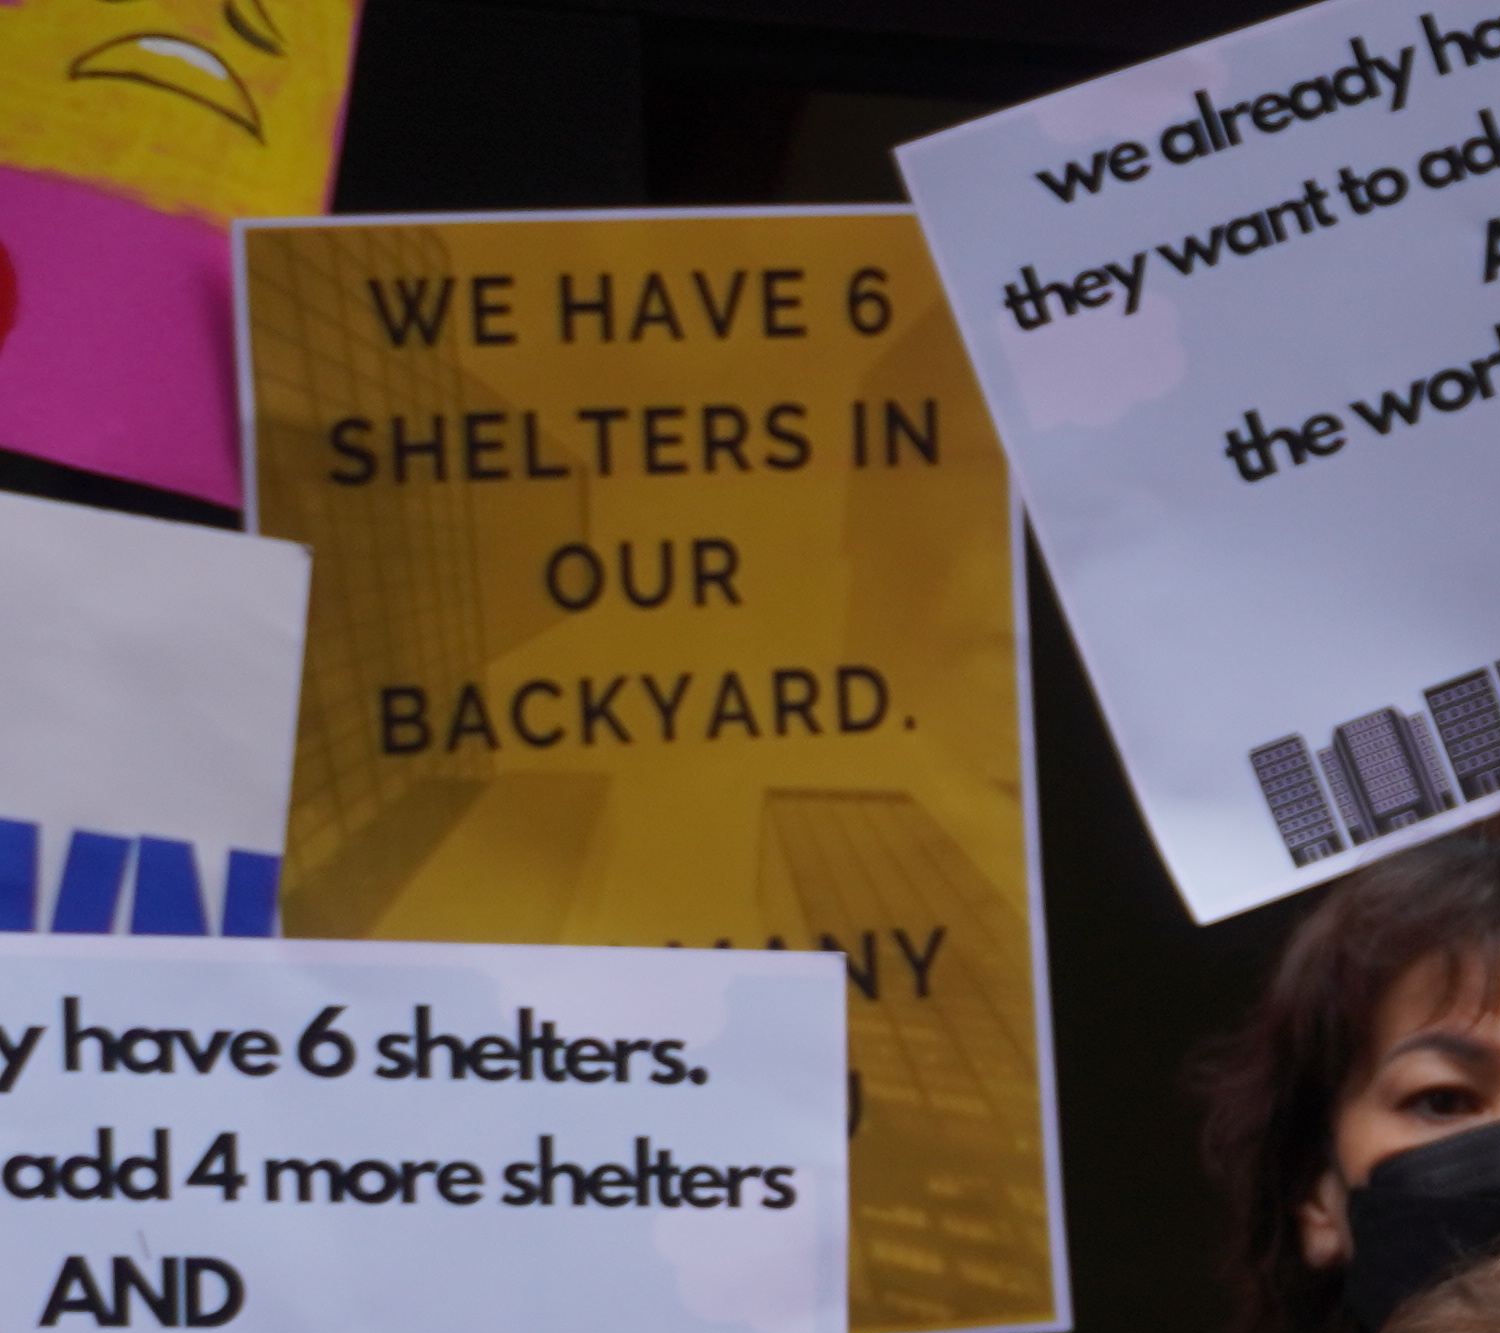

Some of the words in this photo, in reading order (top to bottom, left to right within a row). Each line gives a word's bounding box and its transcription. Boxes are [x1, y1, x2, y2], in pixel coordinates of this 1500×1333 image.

[1035, 138, 1153, 205] we
[1159, 35, 1416, 171] already
[1004, 246, 1151, 333] they
[1157, 183, 1336, 278] want
[1338, 158, 1411, 219] to
[367, 275, 518, 348] WE
[559, 268, 807, 342] HAVE
[846, 266, 893, 337] 6
[328, 403, 812, 486] SHELTERS
[851, 399, 941, 470] IN
[1222, 406, 1347, 485] the
[544, 540, 744, 611] OUR
[379, 666, 917, 756] BACKYARD.
[63, 996, 280, 1078] have
[296, 1003, 357, 1080] 6
[374, 1003, 708, 1086] shelters.
[4, 1127, 172, 1203] add
[186, 1131, 247, 1203] 4
[264, 1149, 484, 1206] more
[501, 1135, 797, 1211] shelters
[38, 1256, 246, 1328] AND
